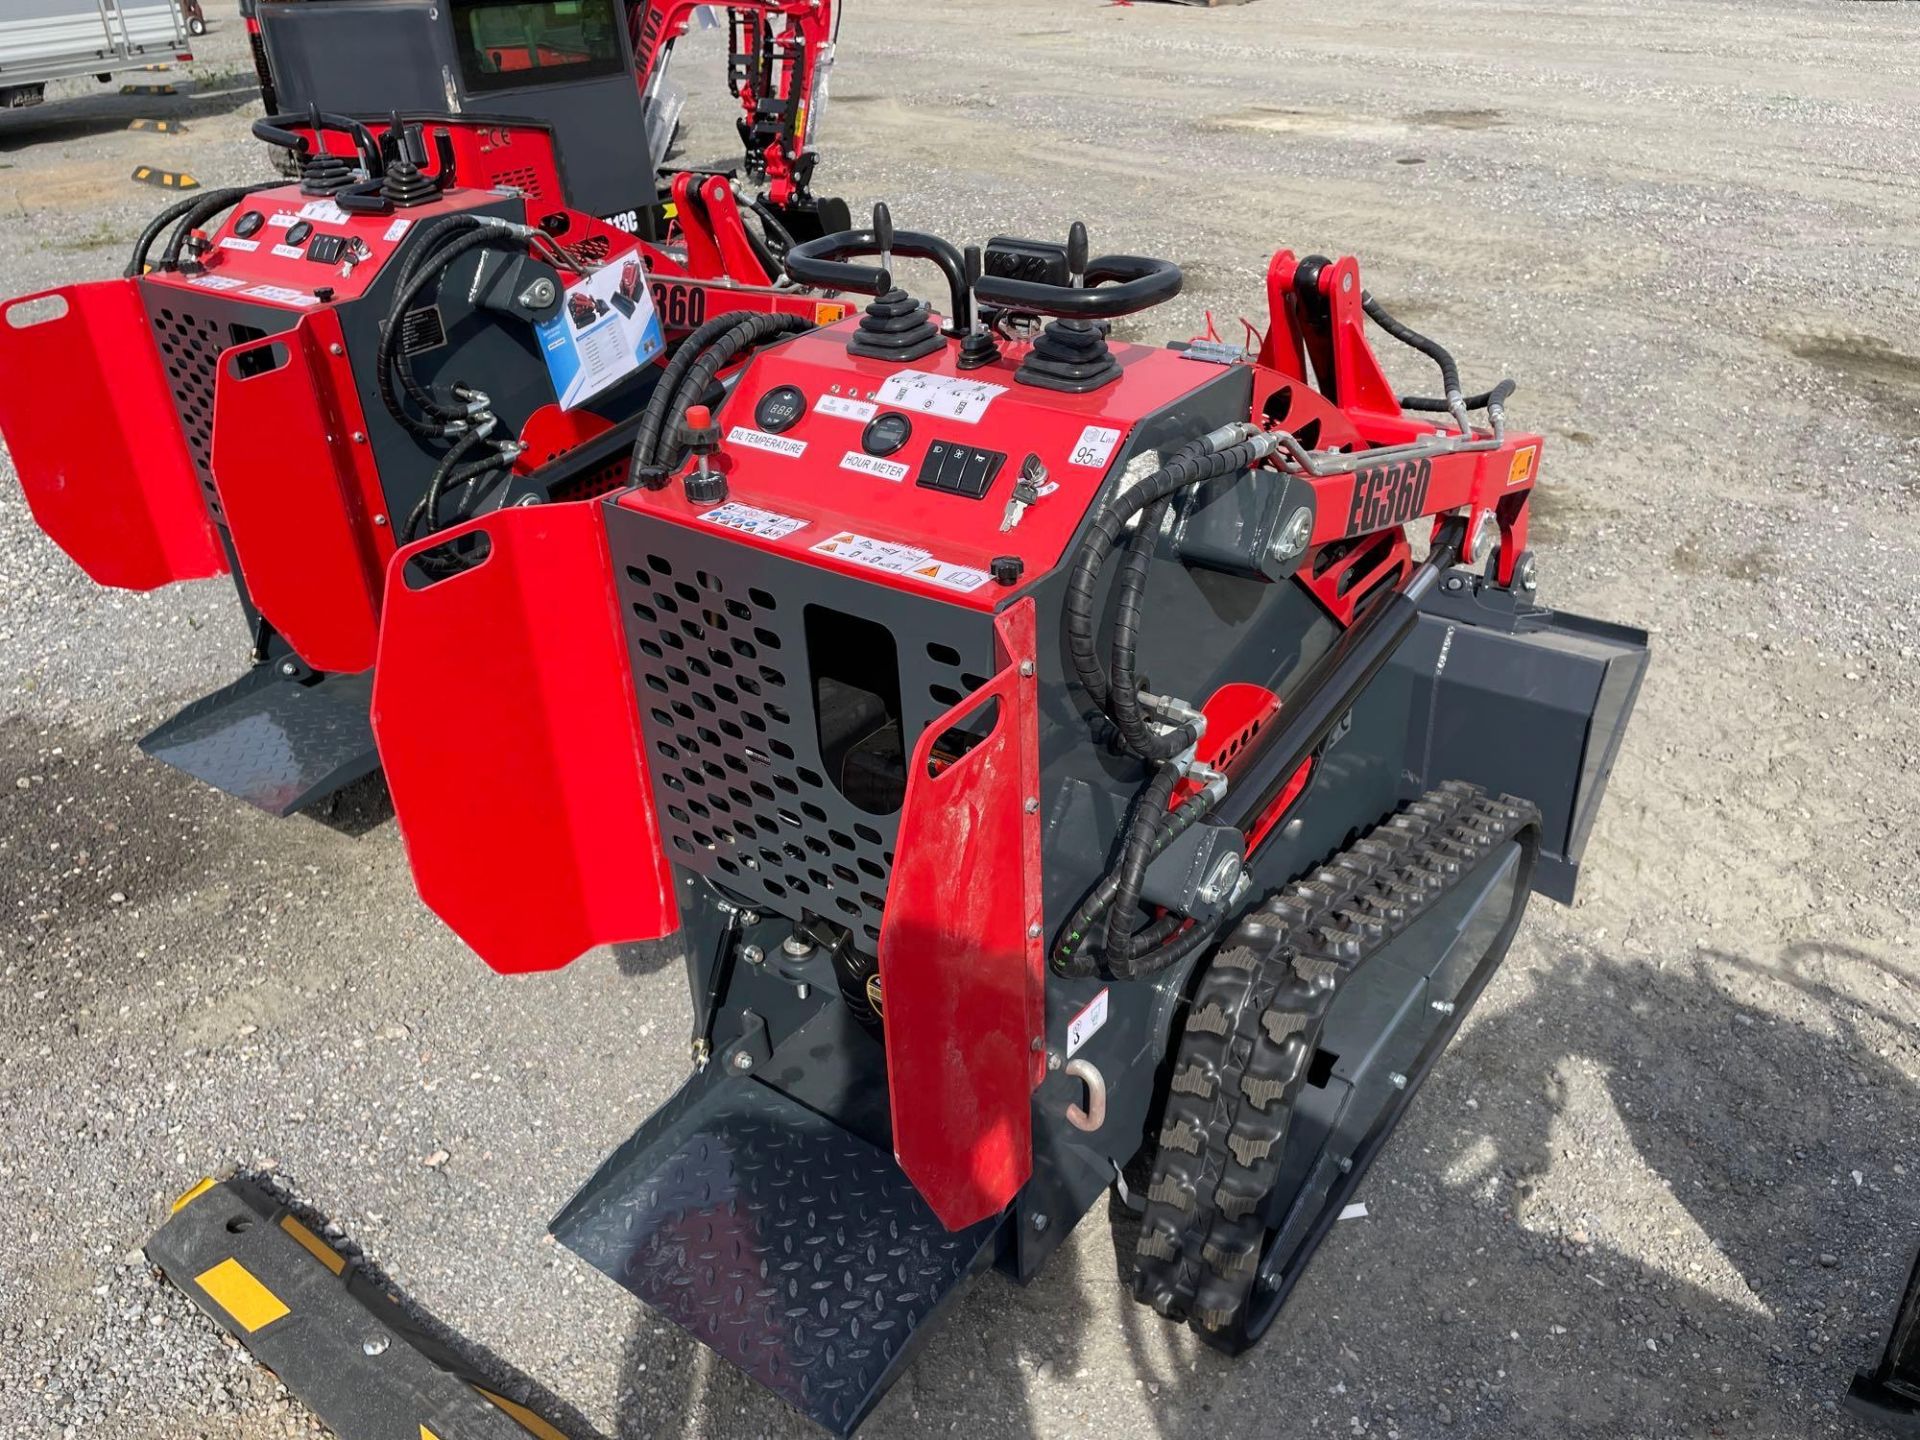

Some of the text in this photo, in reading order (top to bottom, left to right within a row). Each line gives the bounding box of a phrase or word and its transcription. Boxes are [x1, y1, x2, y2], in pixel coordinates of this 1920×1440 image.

[634, 8, 662, 75] MIVA
[745, 433, 804, 454] TEMPERATURE
[844, 456, 904, 477] HOUR METER
[1345, 459, 1432, 537] EG360
